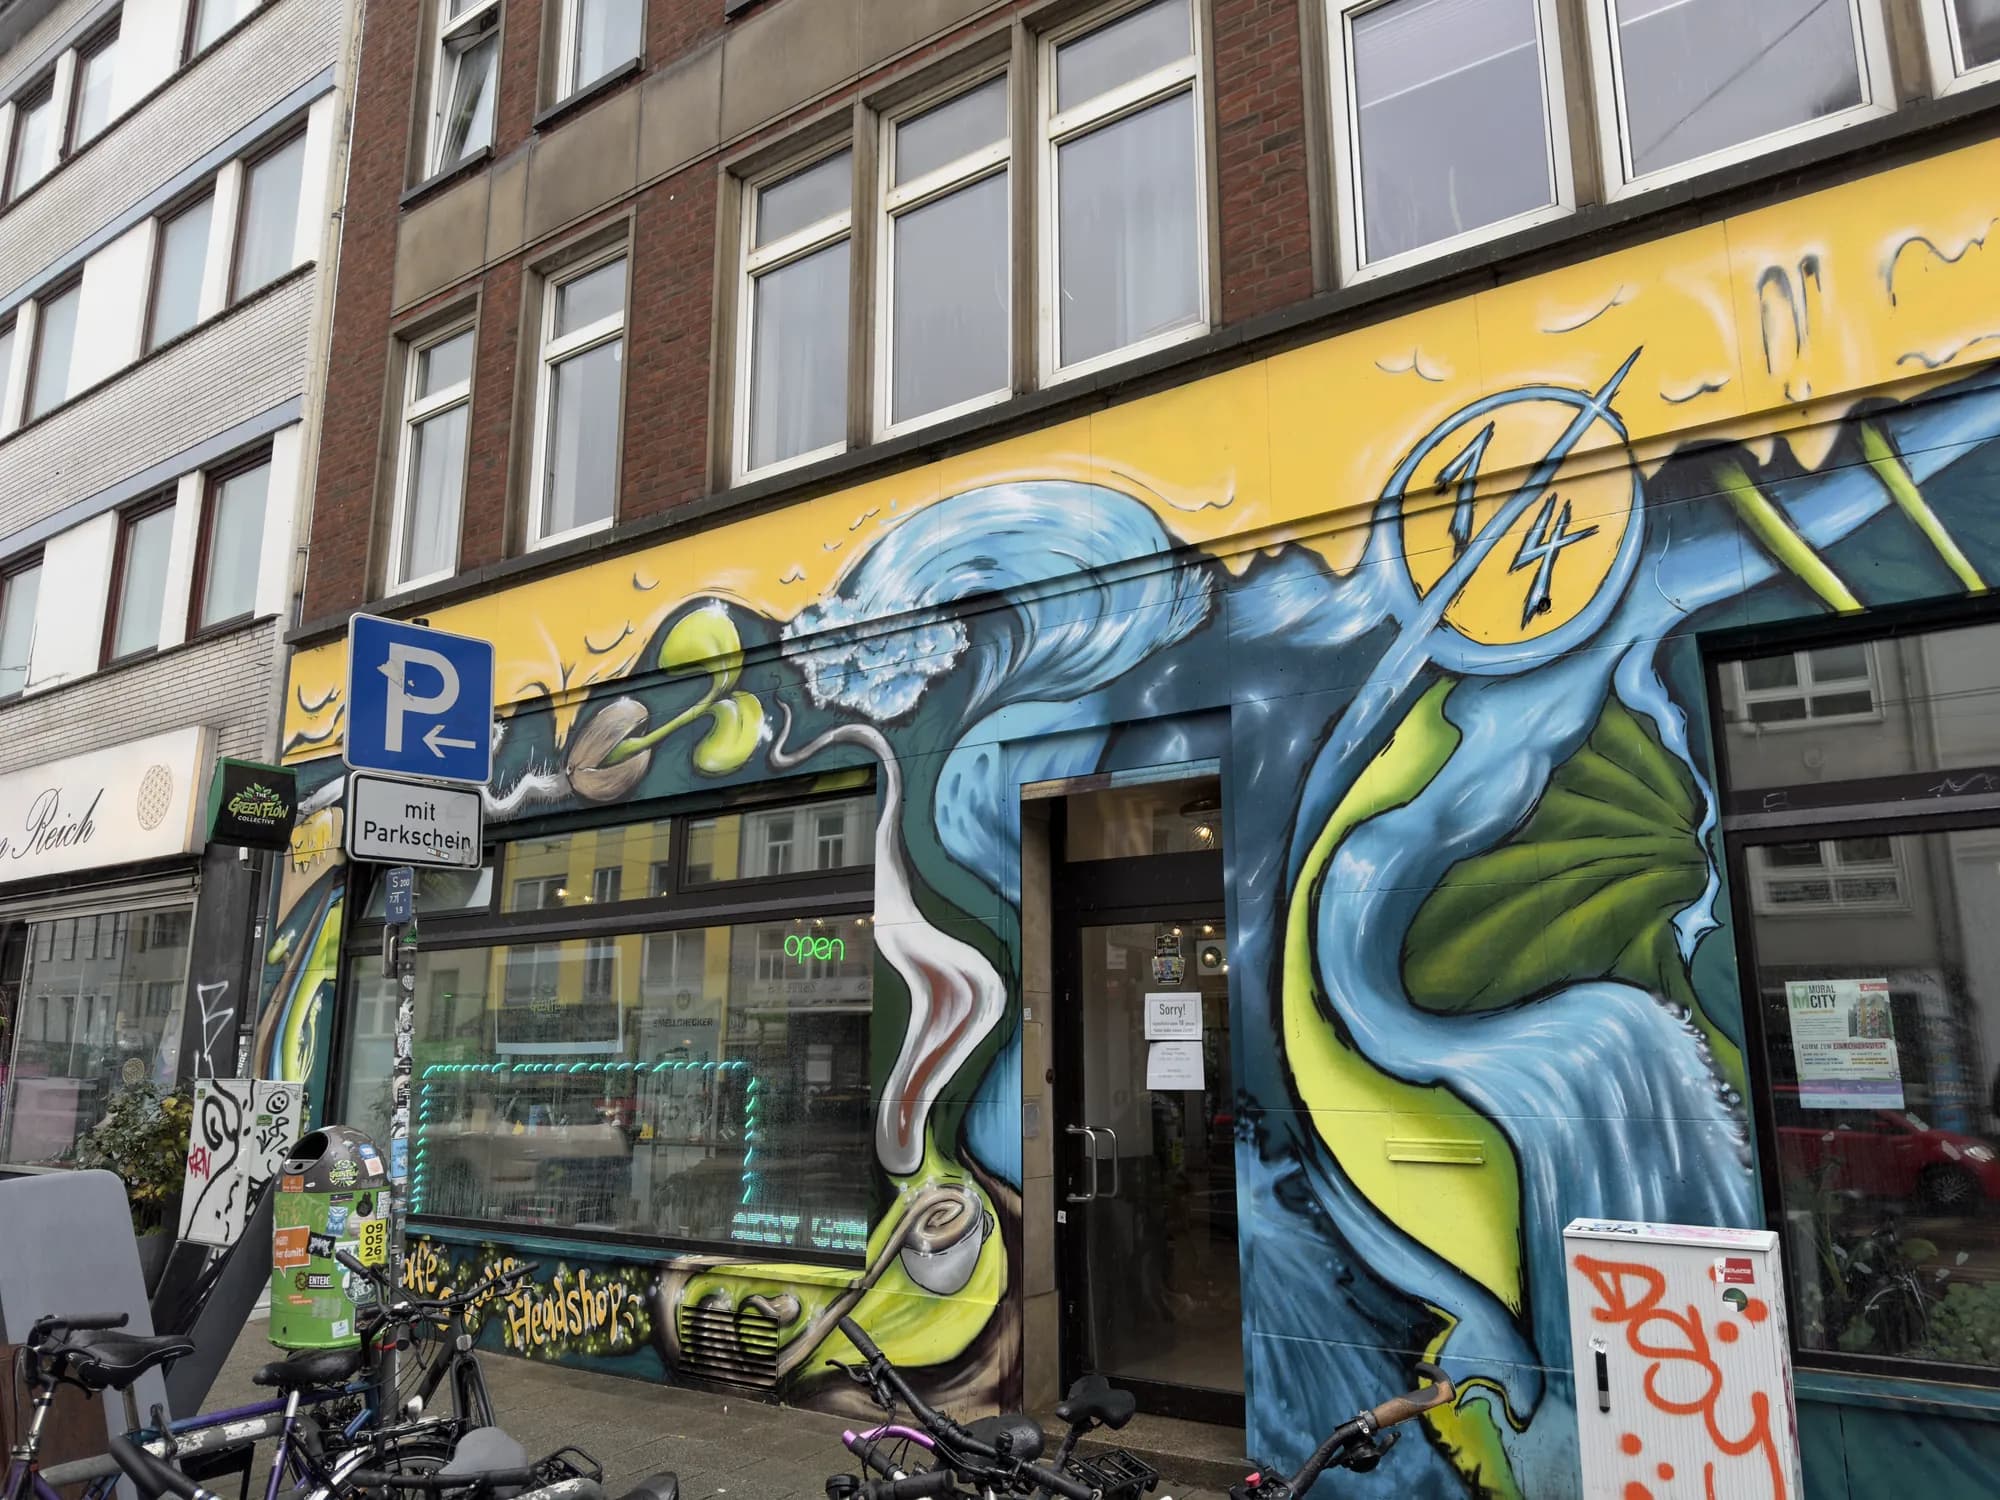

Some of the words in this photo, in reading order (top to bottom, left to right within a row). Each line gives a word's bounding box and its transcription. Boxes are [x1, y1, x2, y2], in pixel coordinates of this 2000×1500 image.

[384, 641, 460, 752] P
[255, 791, 267, 799] THE
[405, 801, 436, 821] mit
[12, 787, 104, 859] Reich
[237, 815, 276, 825] COLLECTIVE
[363, 820, 471, 850] Parkschein
[784, 935, 845, 965] open
[1808, 984, 1836, 994] MURAL
[1810, 994, 1837, 1009] CITY
[1159, 1003, 1186, 1018] Sorry!
[365, 1223, 384, 1235] 09
[365, 1235, 383, 1246] 05
[364, 1246, 382, 1257] 26
[507, 1268, 623, 1348] Headshop
